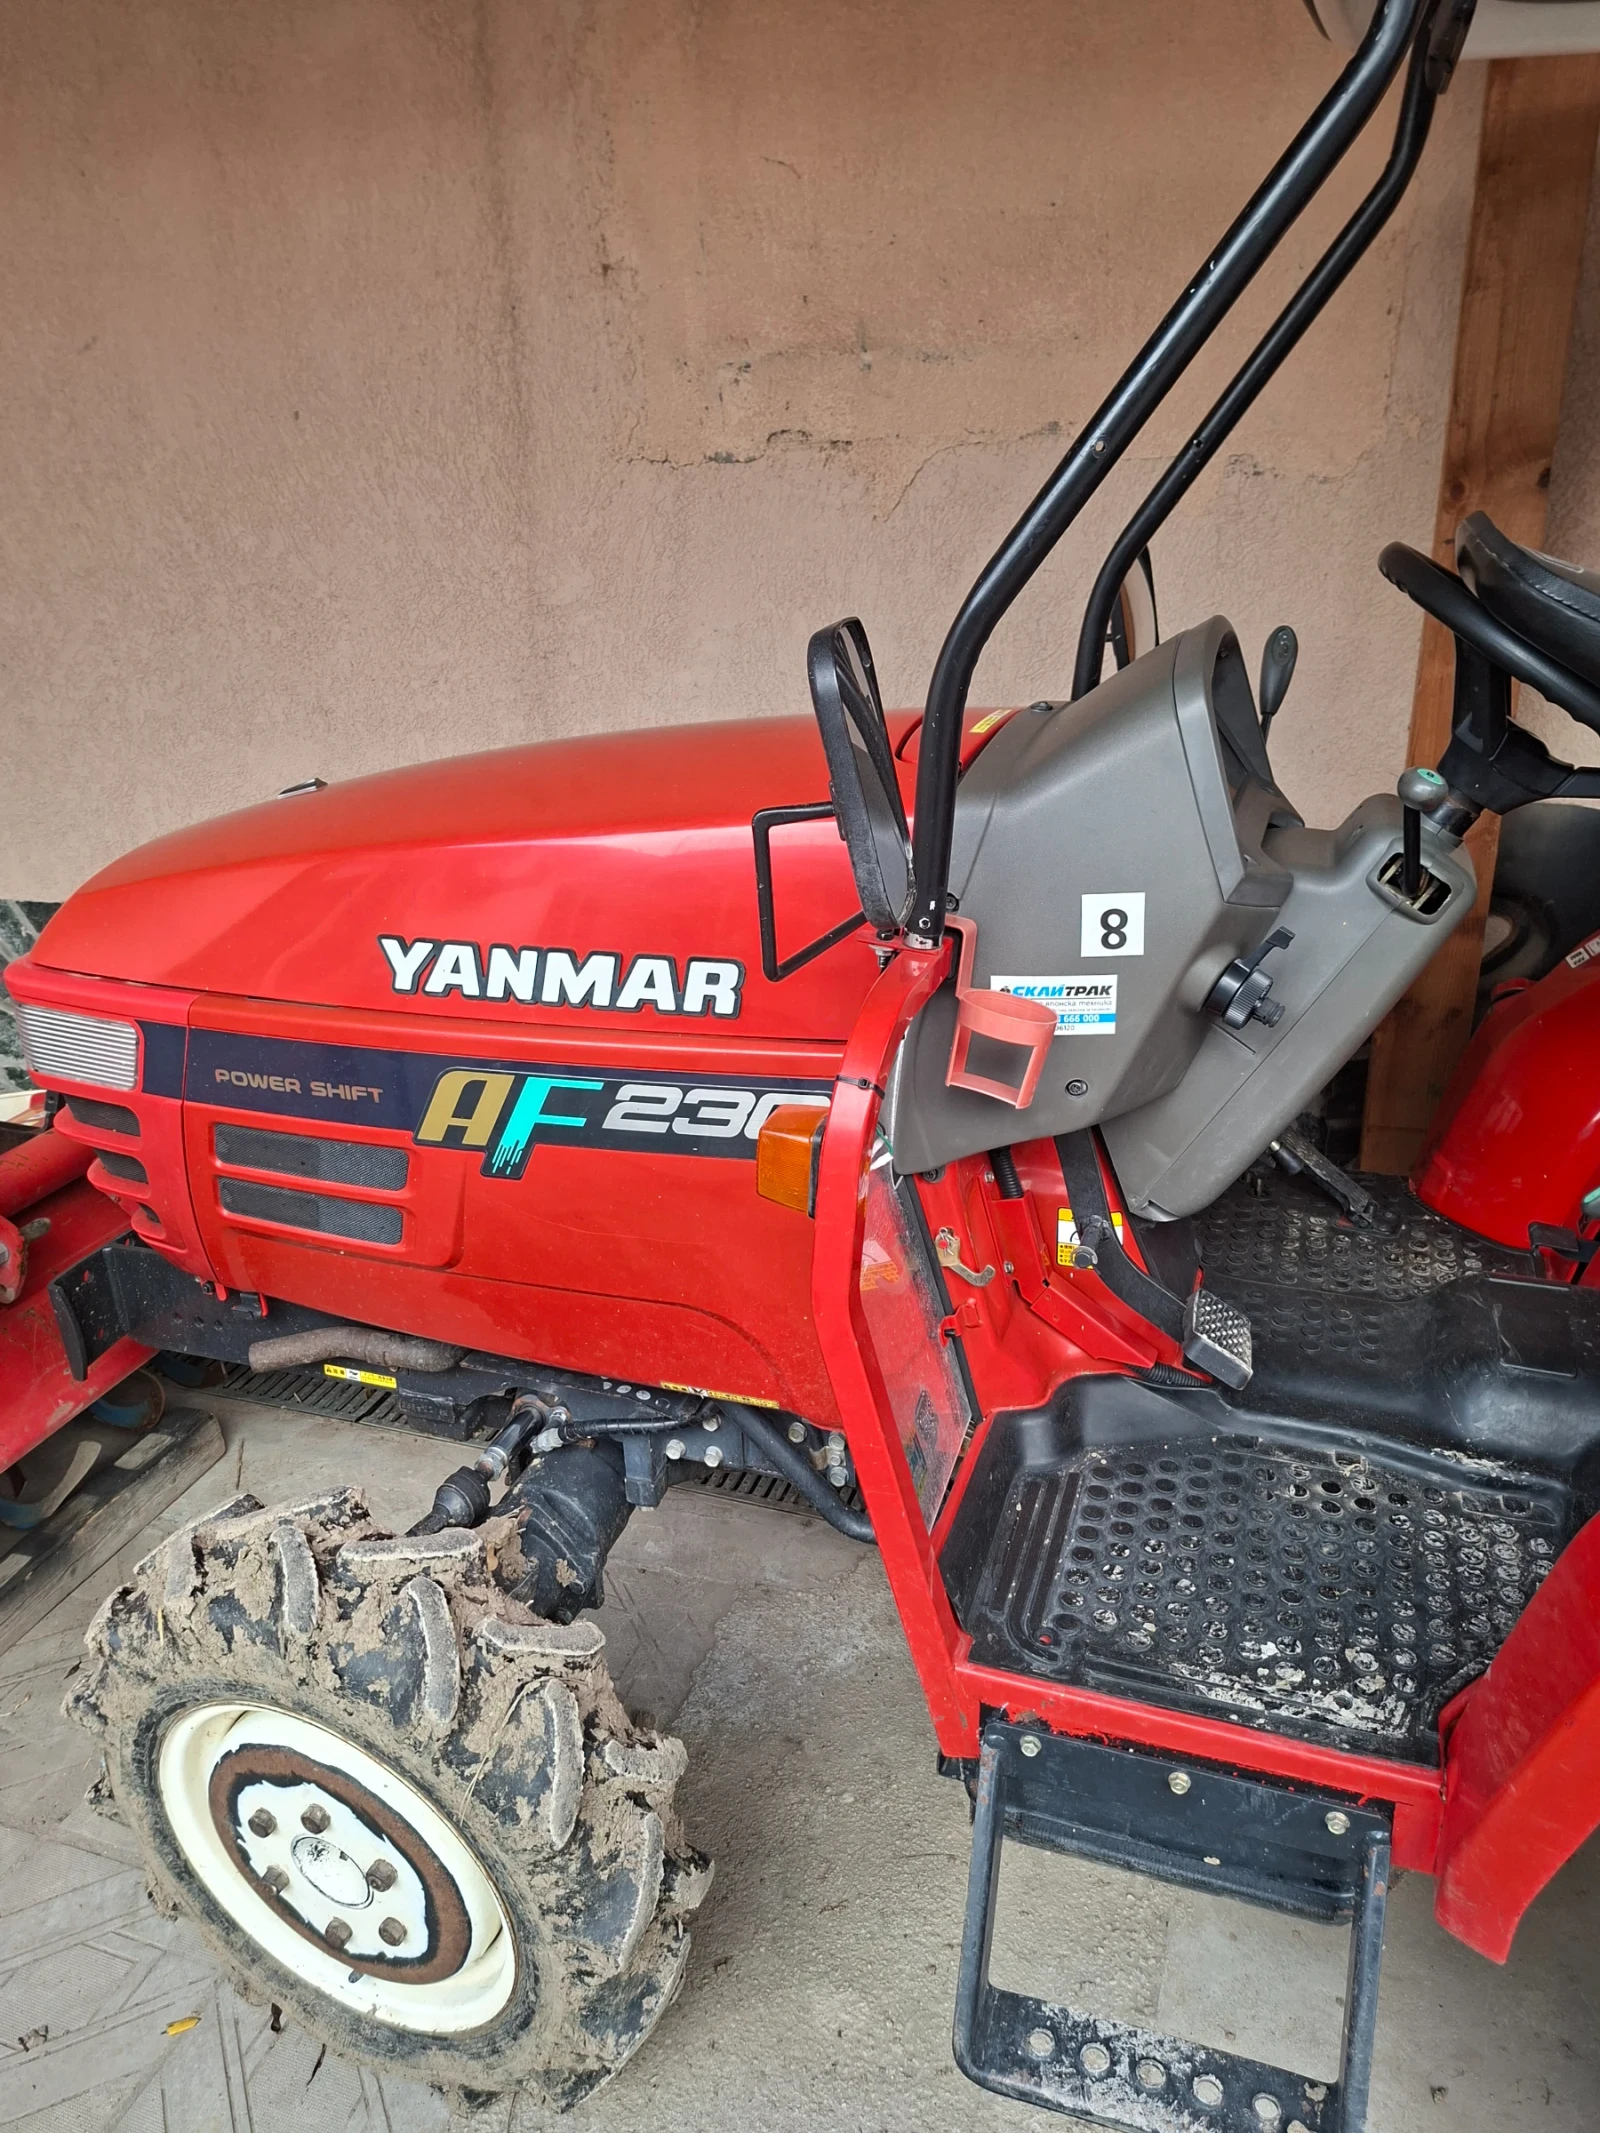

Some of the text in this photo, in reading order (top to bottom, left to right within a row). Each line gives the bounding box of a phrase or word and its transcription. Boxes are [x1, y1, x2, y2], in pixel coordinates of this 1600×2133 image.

[1100, 908, 1128, 950] 8
[379, 937, 743, 1016] YANMAR
[215, 1068, 384, 1104] POWER SHIFT
[417, 1070, 604, 1175] AF
